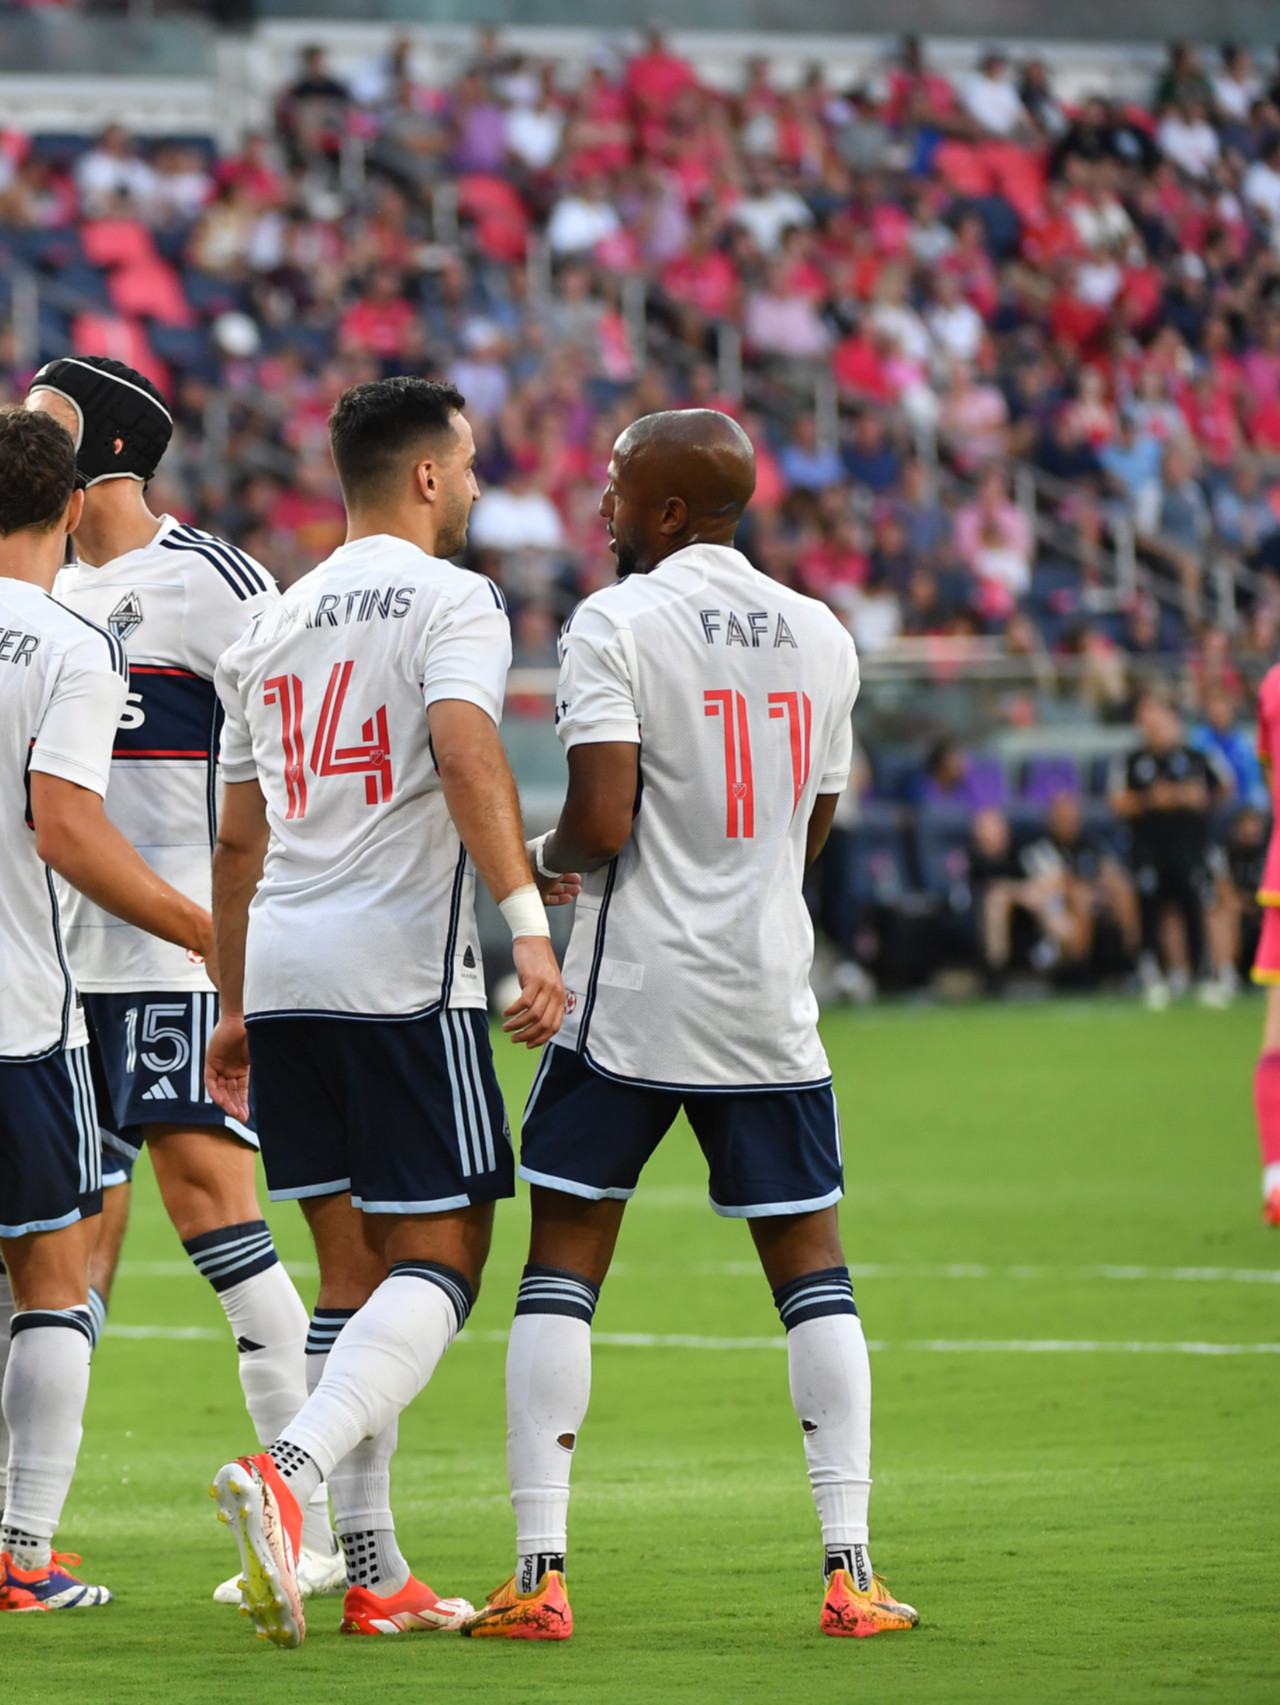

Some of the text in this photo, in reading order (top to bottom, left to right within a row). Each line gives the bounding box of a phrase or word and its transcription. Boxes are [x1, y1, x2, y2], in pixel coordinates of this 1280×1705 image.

[700, 609, 798, 649] FAFA
[263, 660, 393, 819] 14
[703, 689, 813, 838] 11
[124, 1003, 190, 1073] 15
